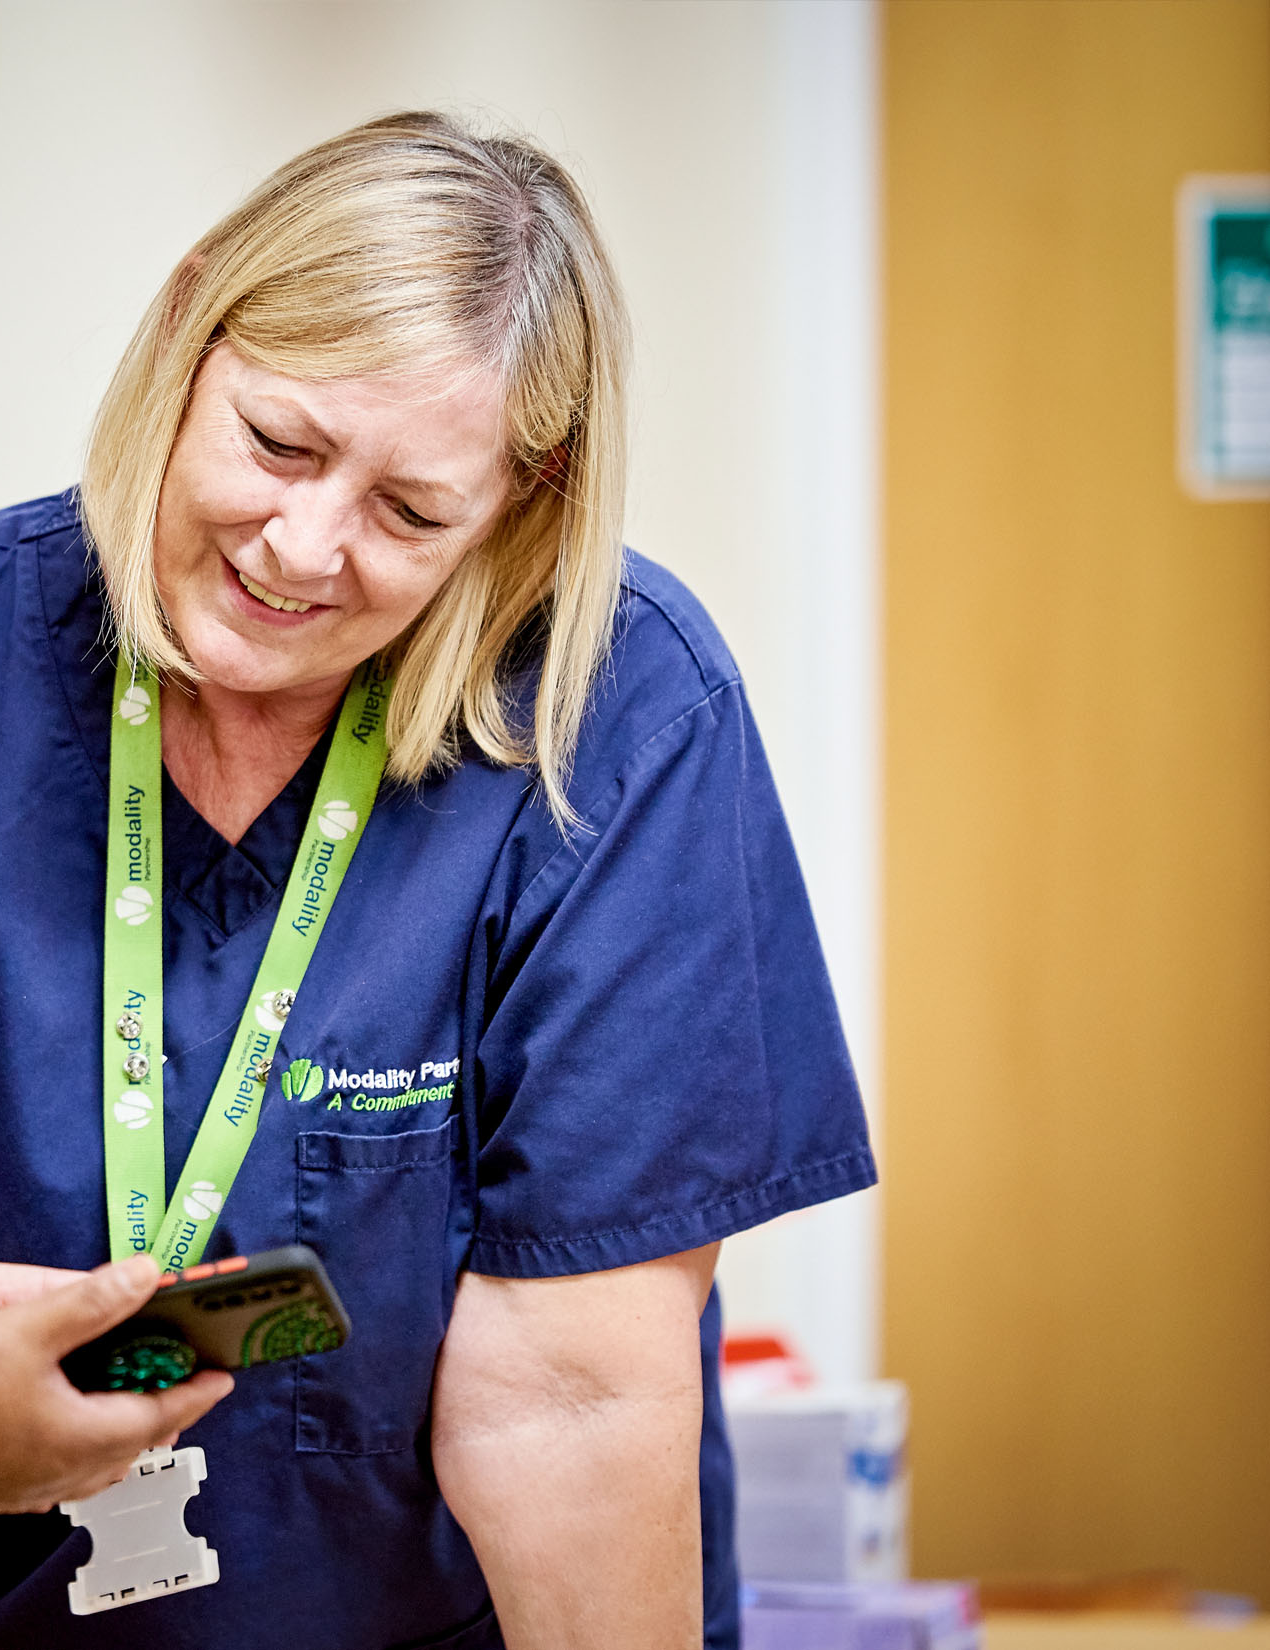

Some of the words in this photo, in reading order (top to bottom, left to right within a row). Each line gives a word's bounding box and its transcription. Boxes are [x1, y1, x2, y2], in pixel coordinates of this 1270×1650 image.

[124, 785, 145, 881] modality
[291, 841, 336, 937] modality
[224, 1032, 271, 1127] modality
[327, 1092, 343, 1111] A
[351, 1080, 455, 1112] Commitment
[328, 1068, 416, 1091] Modality
[420, 1057, 460, 1081] Part
[126, 1189, 149, 1254] dality
